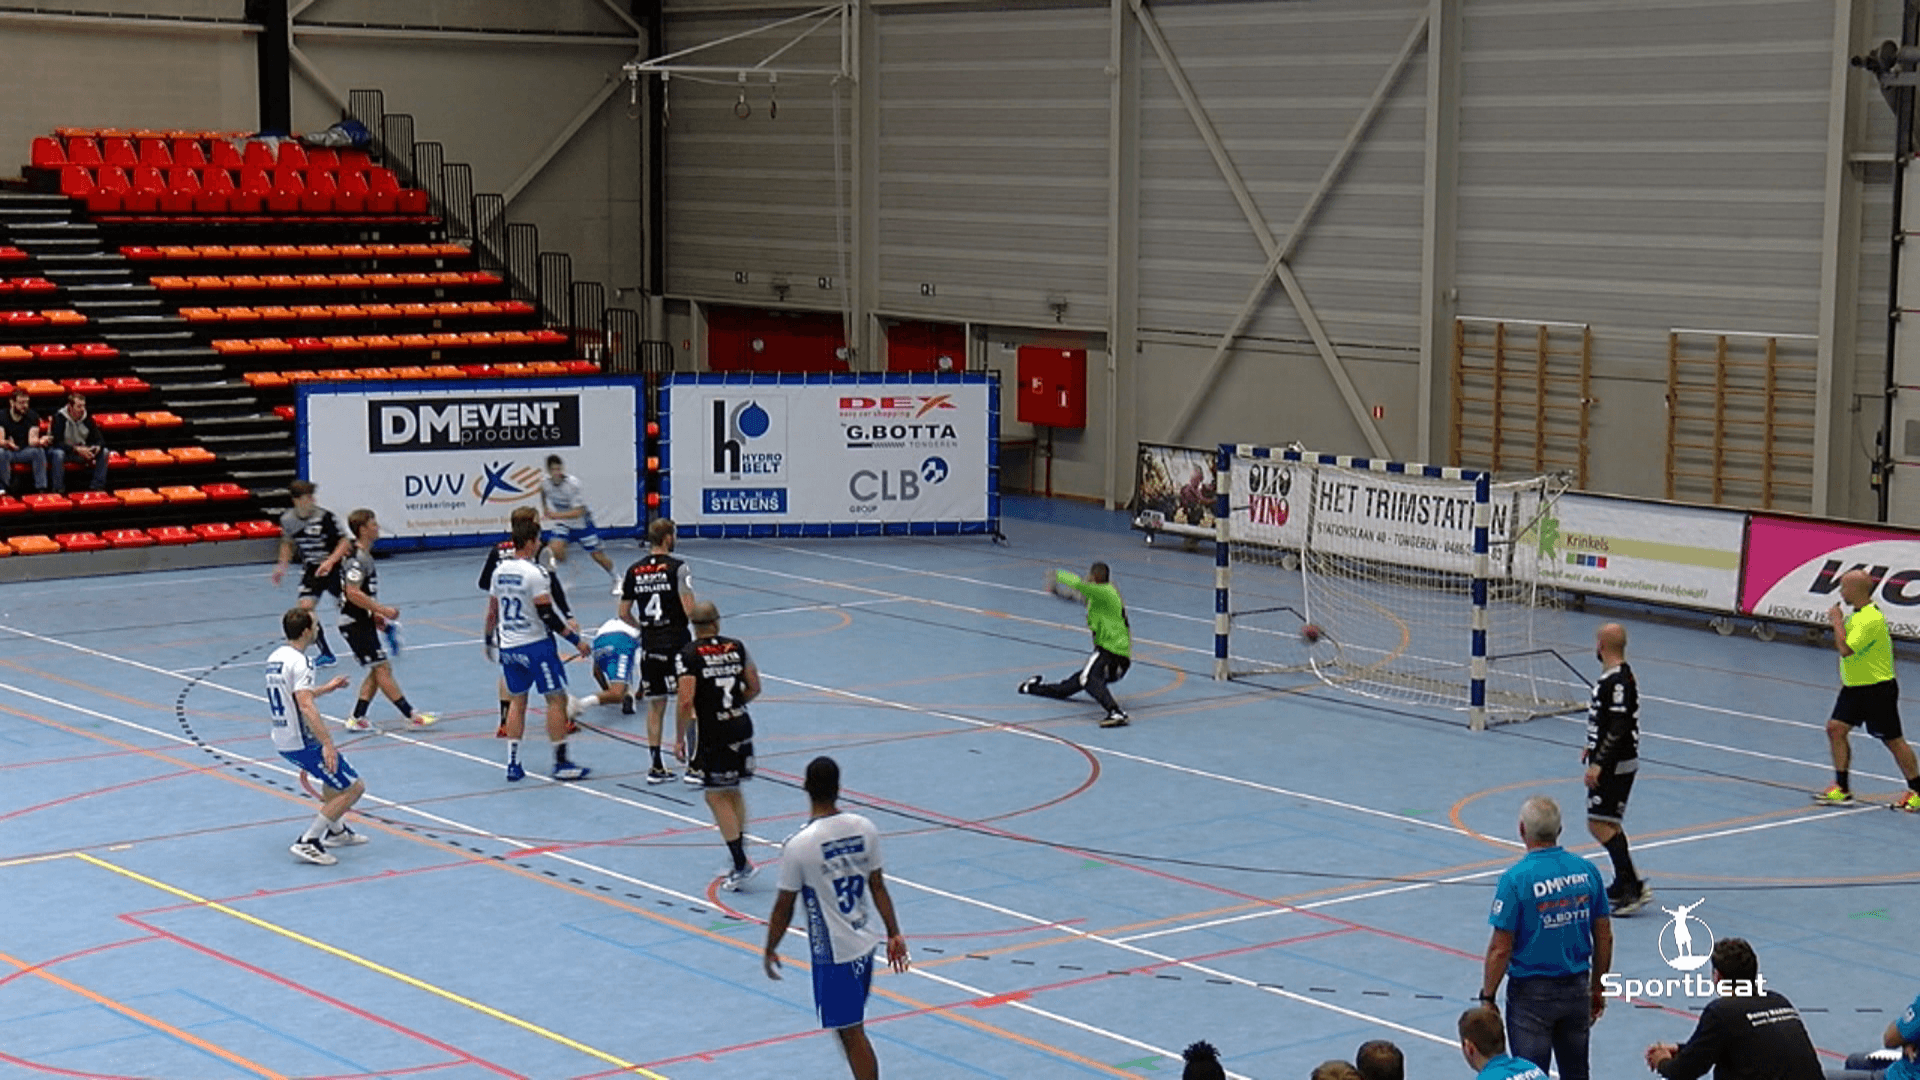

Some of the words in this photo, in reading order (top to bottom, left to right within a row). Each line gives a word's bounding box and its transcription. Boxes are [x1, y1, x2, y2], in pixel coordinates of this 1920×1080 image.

[840, 394, 957, 418] DEX
[461, 425, 561, 447] products
[847, 425, 957, 440] G.BOTTA
[742, 453, 782, 462] HYDRO
[742, 462, 781, 474] BELT
[405, 473, 465, 497] DVV
[849, 469, 920, 502] CLB
[405, 500, 466, 511] verzekeringen
[711, 497, 779, 511] STEVENS
[849, 505, 878, 513] GROUP
[1248, 494, 1290, 527] VINO
[1319, 482, 1359, 513] HET
[1366, 487, 1507, 536] TRIMSTATIN
[1394, 533, 1437, 551] TONGEREN
[1567, 533, 1609, 551] Krinkels
[501, 596, 526, 621] 22
[644, 593, 663, 621] 4
[714, 676, 736, 709] 7
